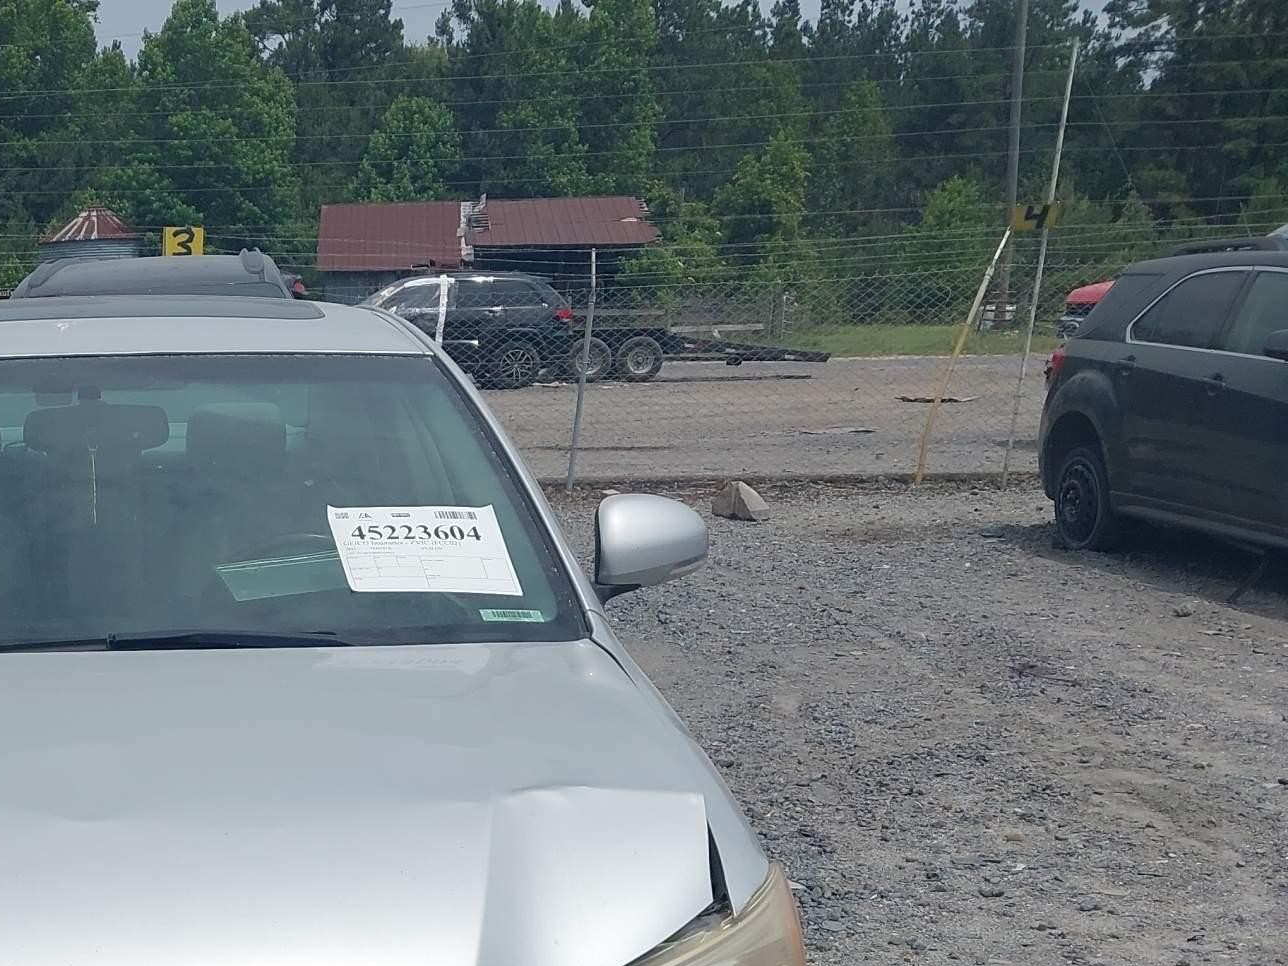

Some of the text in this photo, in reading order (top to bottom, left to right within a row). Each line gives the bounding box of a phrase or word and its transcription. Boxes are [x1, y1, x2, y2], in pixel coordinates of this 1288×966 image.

[1024, 205, 1051, 229] 4
[172, 227, 195, 256] 3
[352, 525, 482, 541] 45223604
